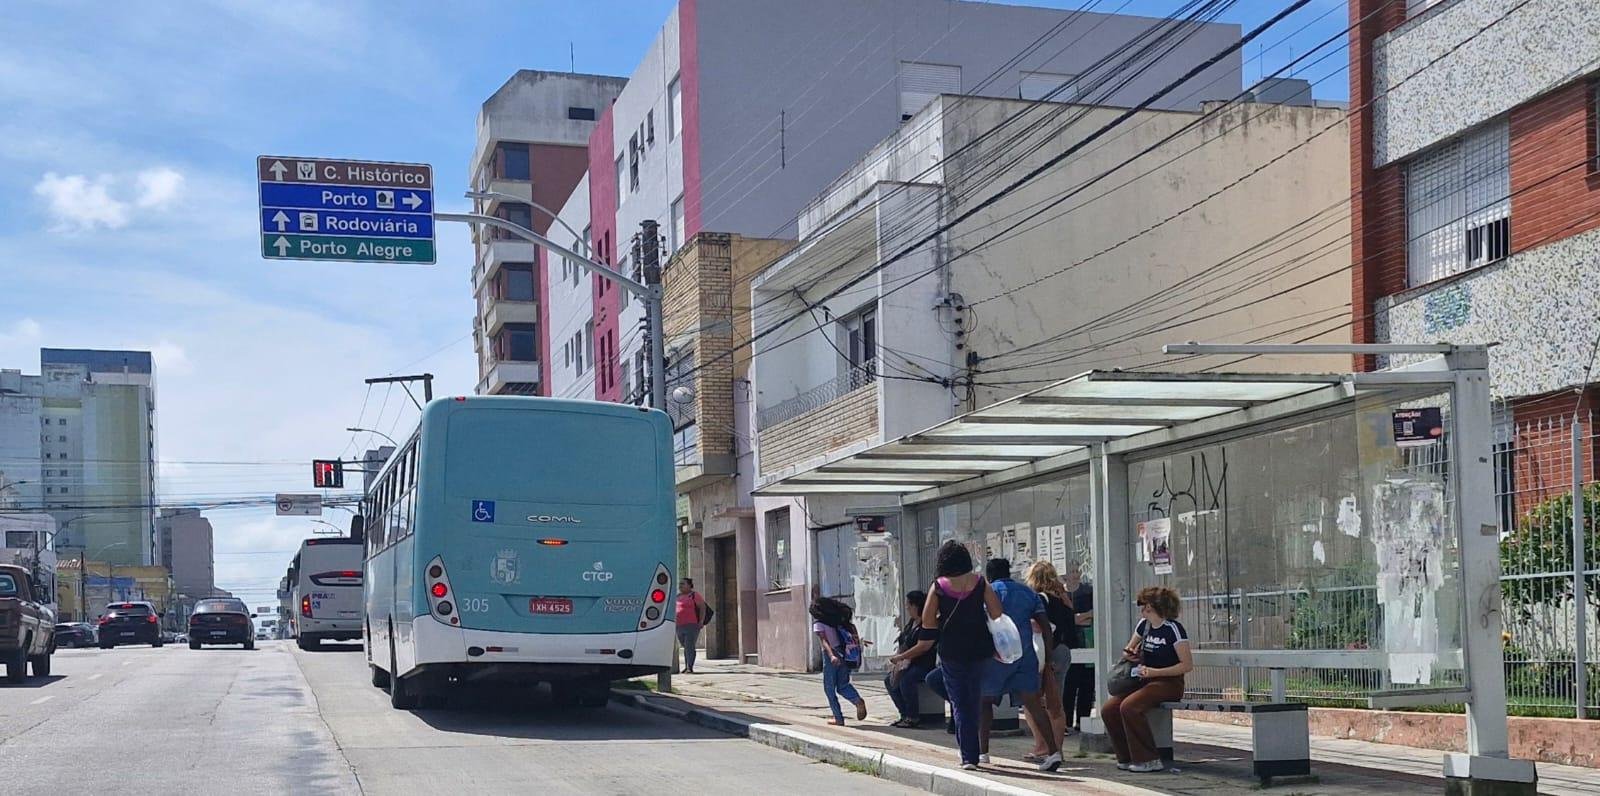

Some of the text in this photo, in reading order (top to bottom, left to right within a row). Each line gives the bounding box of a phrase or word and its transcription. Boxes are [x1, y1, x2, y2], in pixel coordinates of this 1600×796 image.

[324, 166, 425, 184] C. Histórico
[321, 191, 368, 206] Porto
[325, 216, 418, 234] Rodoviária
[300, 240, 412, 259] Porto Alegre
[527, 515, 581, 523] COMIL
[582, 571, 613, 582] CTCP
[463, 598, 489, 612] 305
[549, 604, 570, 613] 4525
